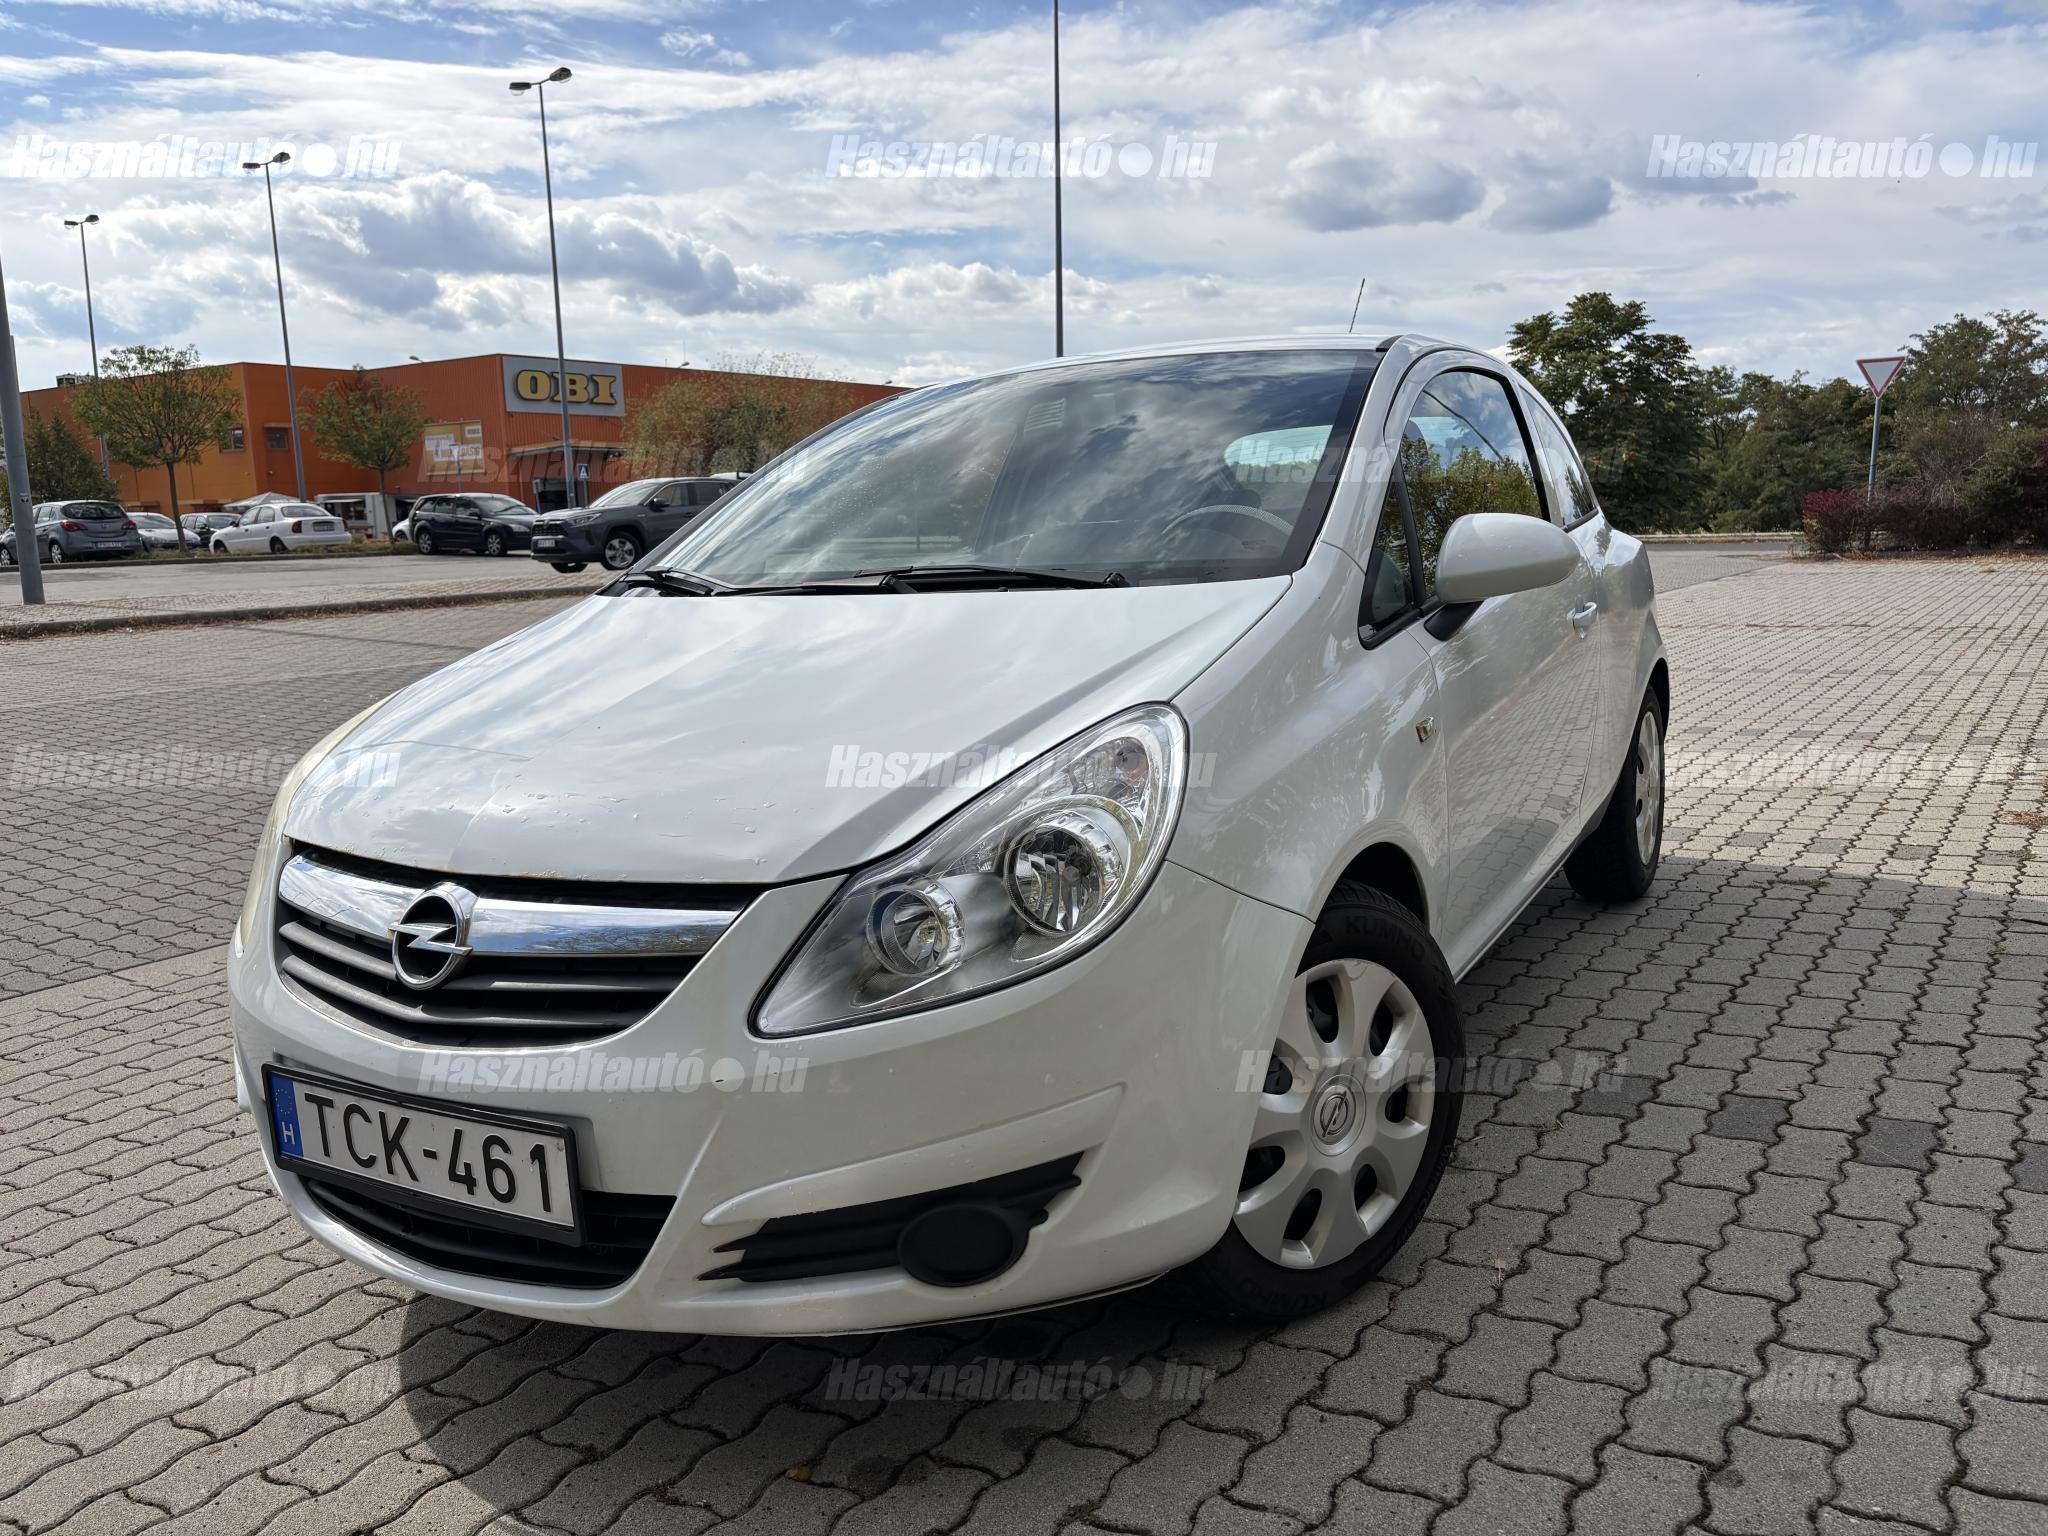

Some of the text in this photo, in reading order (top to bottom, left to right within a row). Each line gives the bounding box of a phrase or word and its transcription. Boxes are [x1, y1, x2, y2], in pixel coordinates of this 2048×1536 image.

[516, 369, 617, 405] OBI
[281, 1121, 296, 1145] H
[304, 1092, 551, 1212] TCK-461
